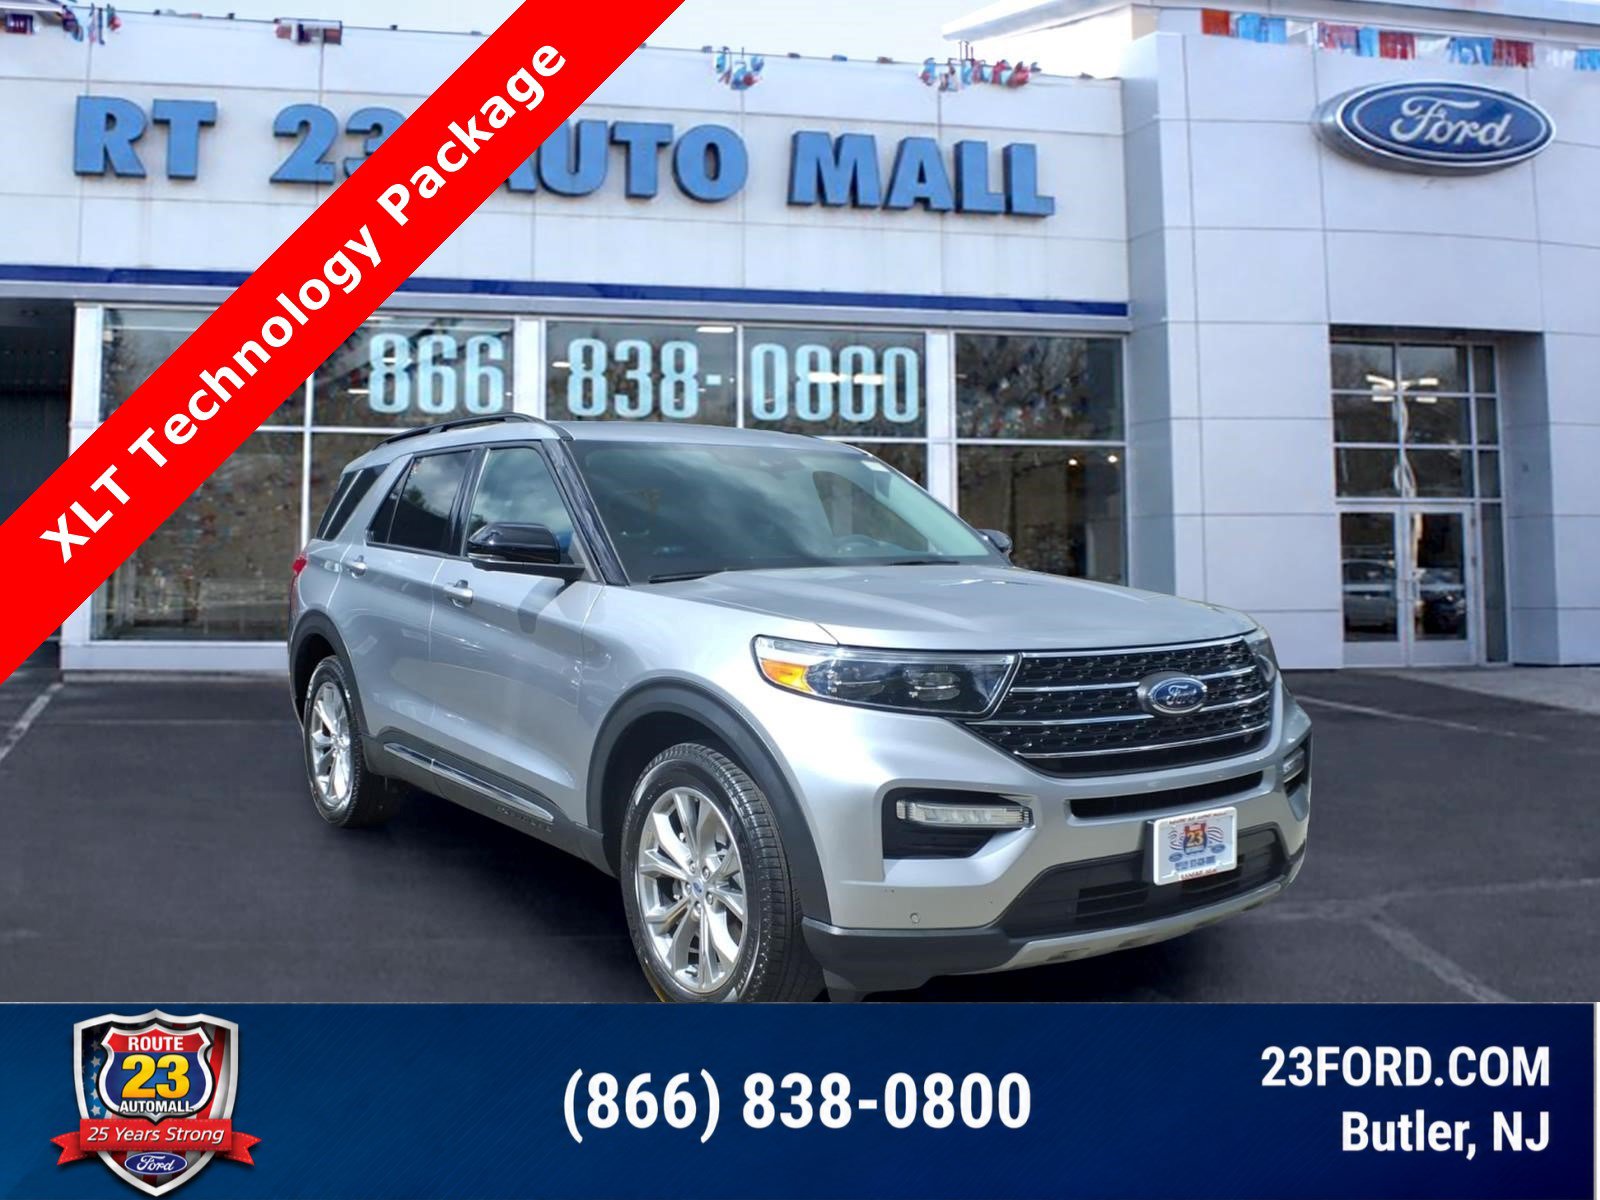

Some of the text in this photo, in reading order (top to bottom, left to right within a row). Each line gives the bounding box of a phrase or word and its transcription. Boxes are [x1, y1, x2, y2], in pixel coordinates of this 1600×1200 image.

[73, 96, 218, 180] RT
[504, 118, 748, 203] UTO
[787, 130, 1056, 218] MALL
[1390, 95, 1512, 146] Ford
[368, 332, 505, 415] 866
